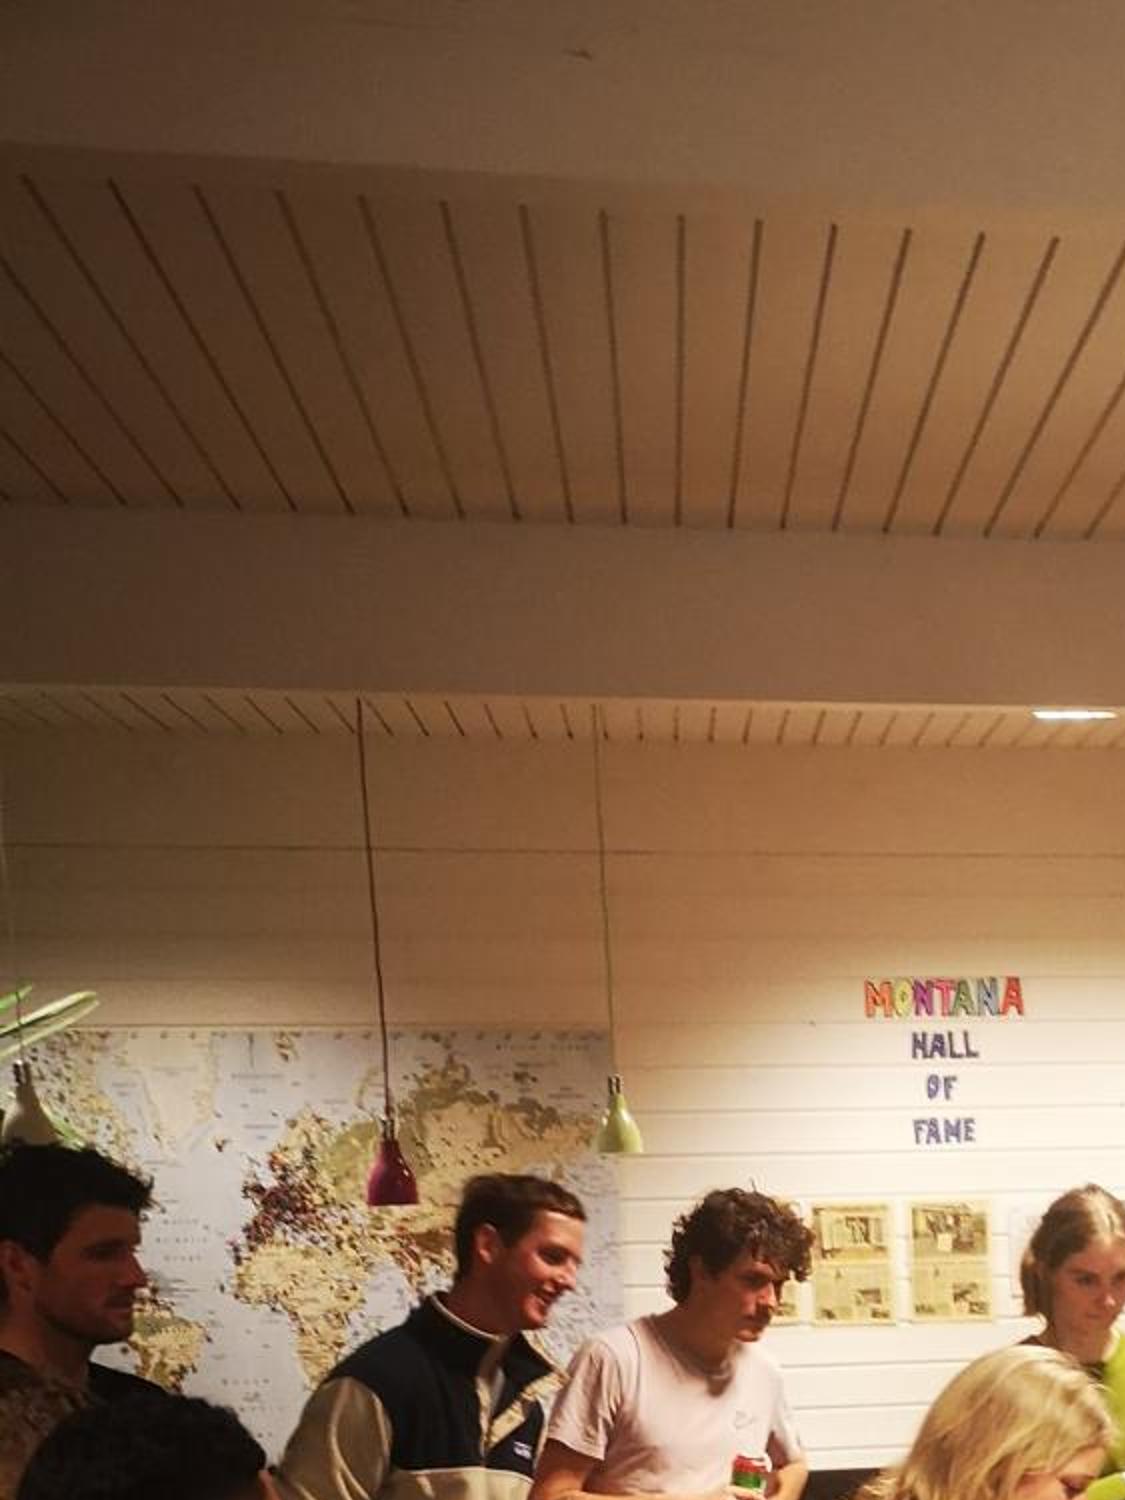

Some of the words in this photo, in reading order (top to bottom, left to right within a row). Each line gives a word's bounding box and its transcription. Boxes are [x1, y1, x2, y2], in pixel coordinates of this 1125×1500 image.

[864, 977, 1024, 1017] MONTANA
[912, 1031, 979, 1059] HALL
[927, 1074, 958, 1100] OF
[912, 1117, 976, 1144] FAME
